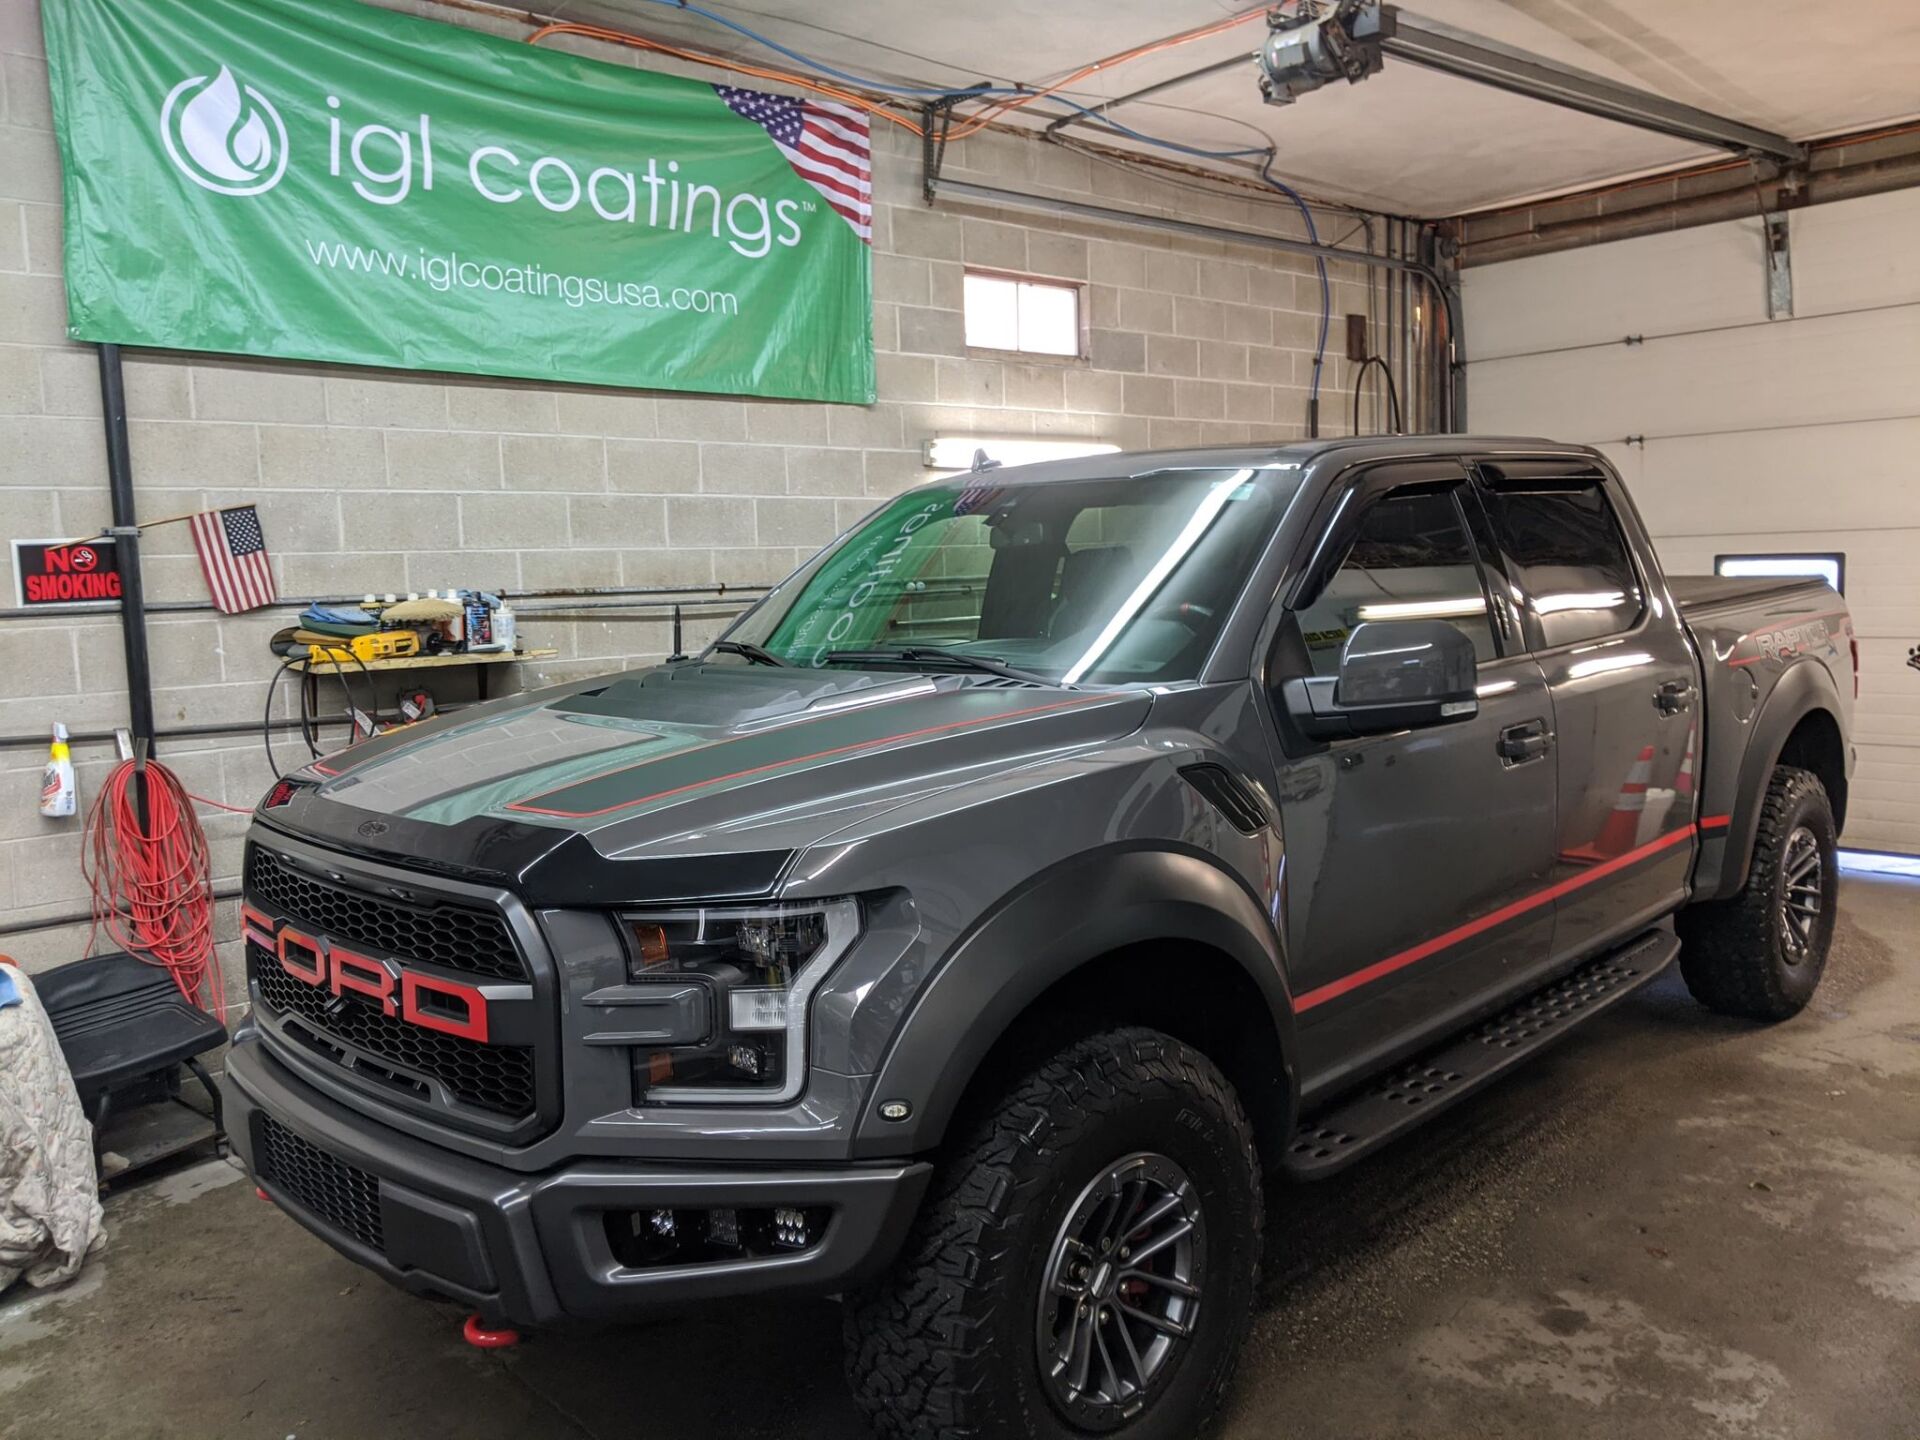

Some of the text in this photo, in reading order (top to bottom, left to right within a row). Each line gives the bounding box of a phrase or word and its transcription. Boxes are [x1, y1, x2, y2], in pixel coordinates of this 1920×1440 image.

[326, 96, 432, 205] igl
[469, 146, 801, 258] coatings
[305, 239, 739, 316] www.iglcoatingsusa.com
[26, 572, 122, 601] SMOKING
[240, 903, 489, 1044] FORD
